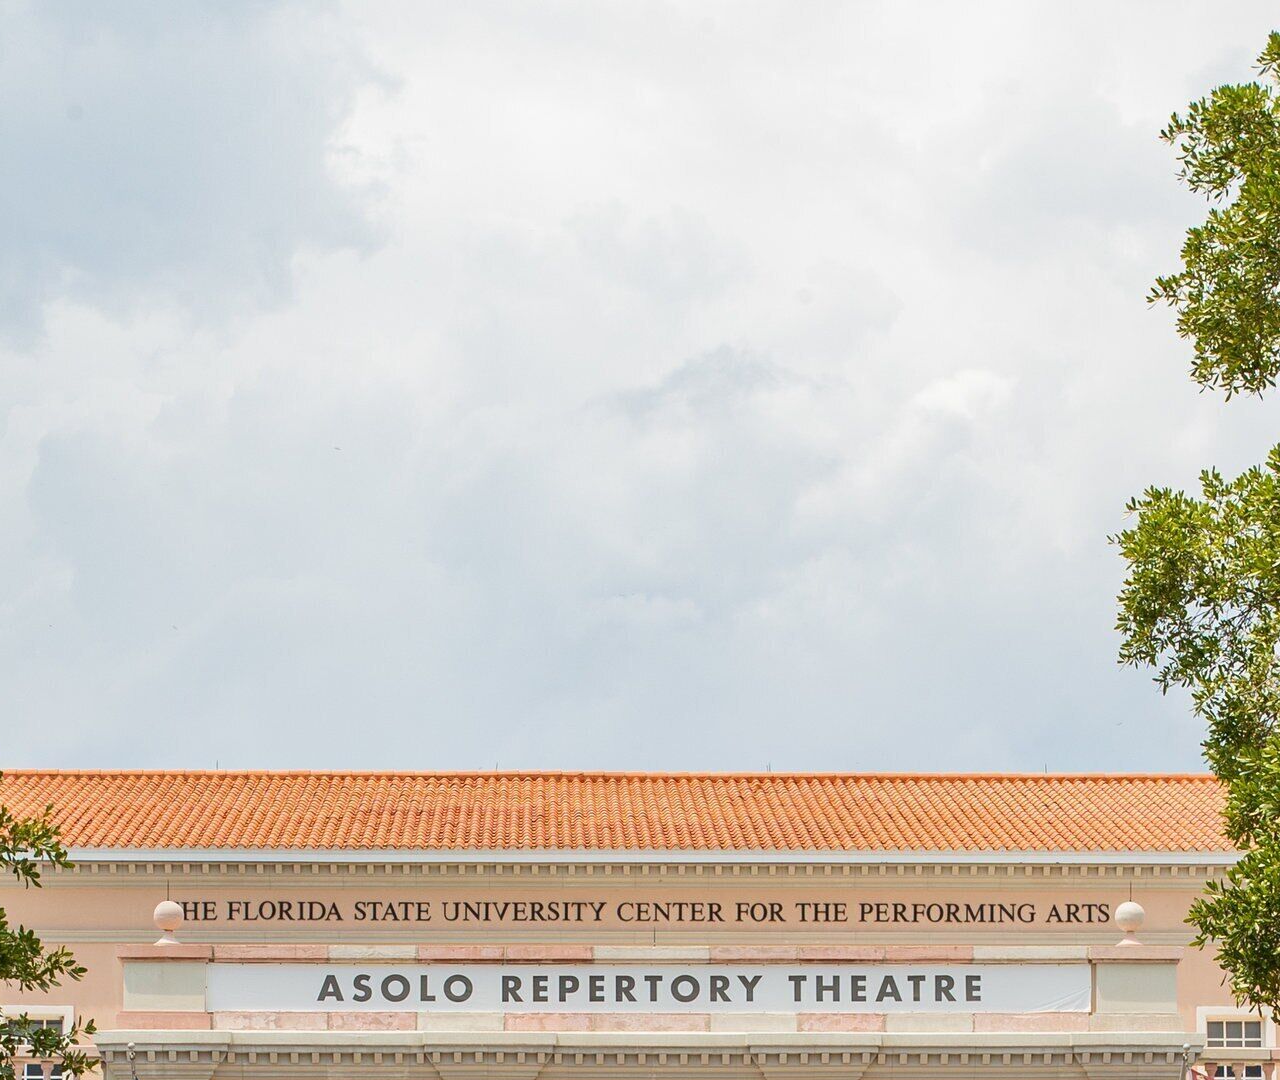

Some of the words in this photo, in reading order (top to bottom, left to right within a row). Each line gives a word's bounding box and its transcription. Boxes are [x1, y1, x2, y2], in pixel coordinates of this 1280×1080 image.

[175, 901, 218, 921] HE
[227, 901, 343, 922] FLORIDA
[354, 901, 431, 921] STATE
[443, 902, 607, 922] UNIVERSITY
[617, 902, 722, 922] CENTER
[735, 903, 790, 923] FOR
[795, 903, 848, 923] THE
[859, 903, 1037, 924] PERFORMING
[1045, 903, 1111, 923] ARTS
[317, 974, 474, 1003] ASOLO
[502, 975, 763, 1003] REPERTORY
[788, 975, 982, 1003] THEATRE
